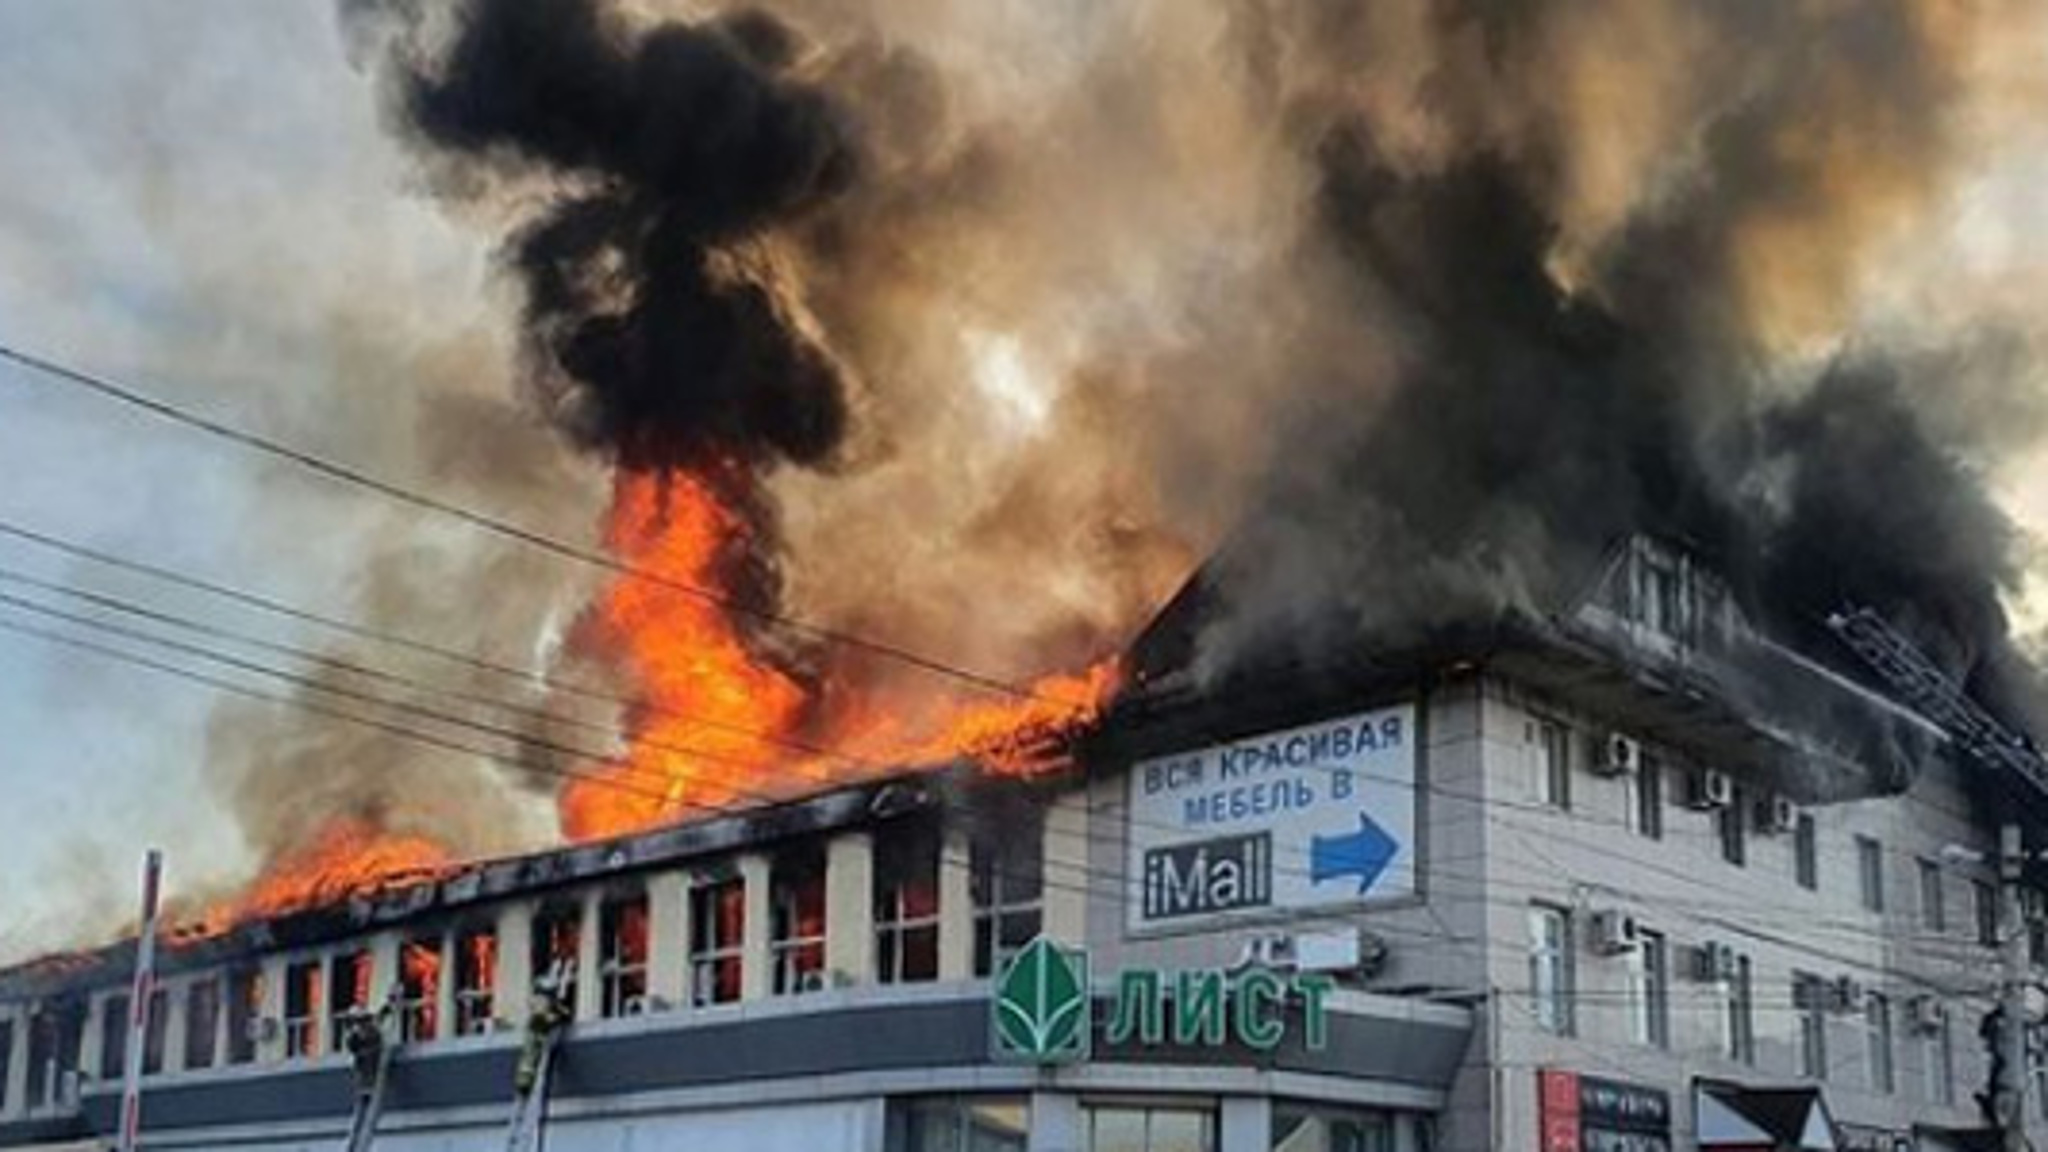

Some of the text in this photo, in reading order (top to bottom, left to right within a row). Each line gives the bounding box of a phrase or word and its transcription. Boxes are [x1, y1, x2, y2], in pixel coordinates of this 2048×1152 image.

[1144, 716, 1402, 795] ВСЯ КРАСИВАЯ
[1184, 769, 1354, 825] МЕБЕЛЬ В
[1148, 837, 1266, 914] iMall
[1105, 967, 1338, 1050] ЛИСТ
